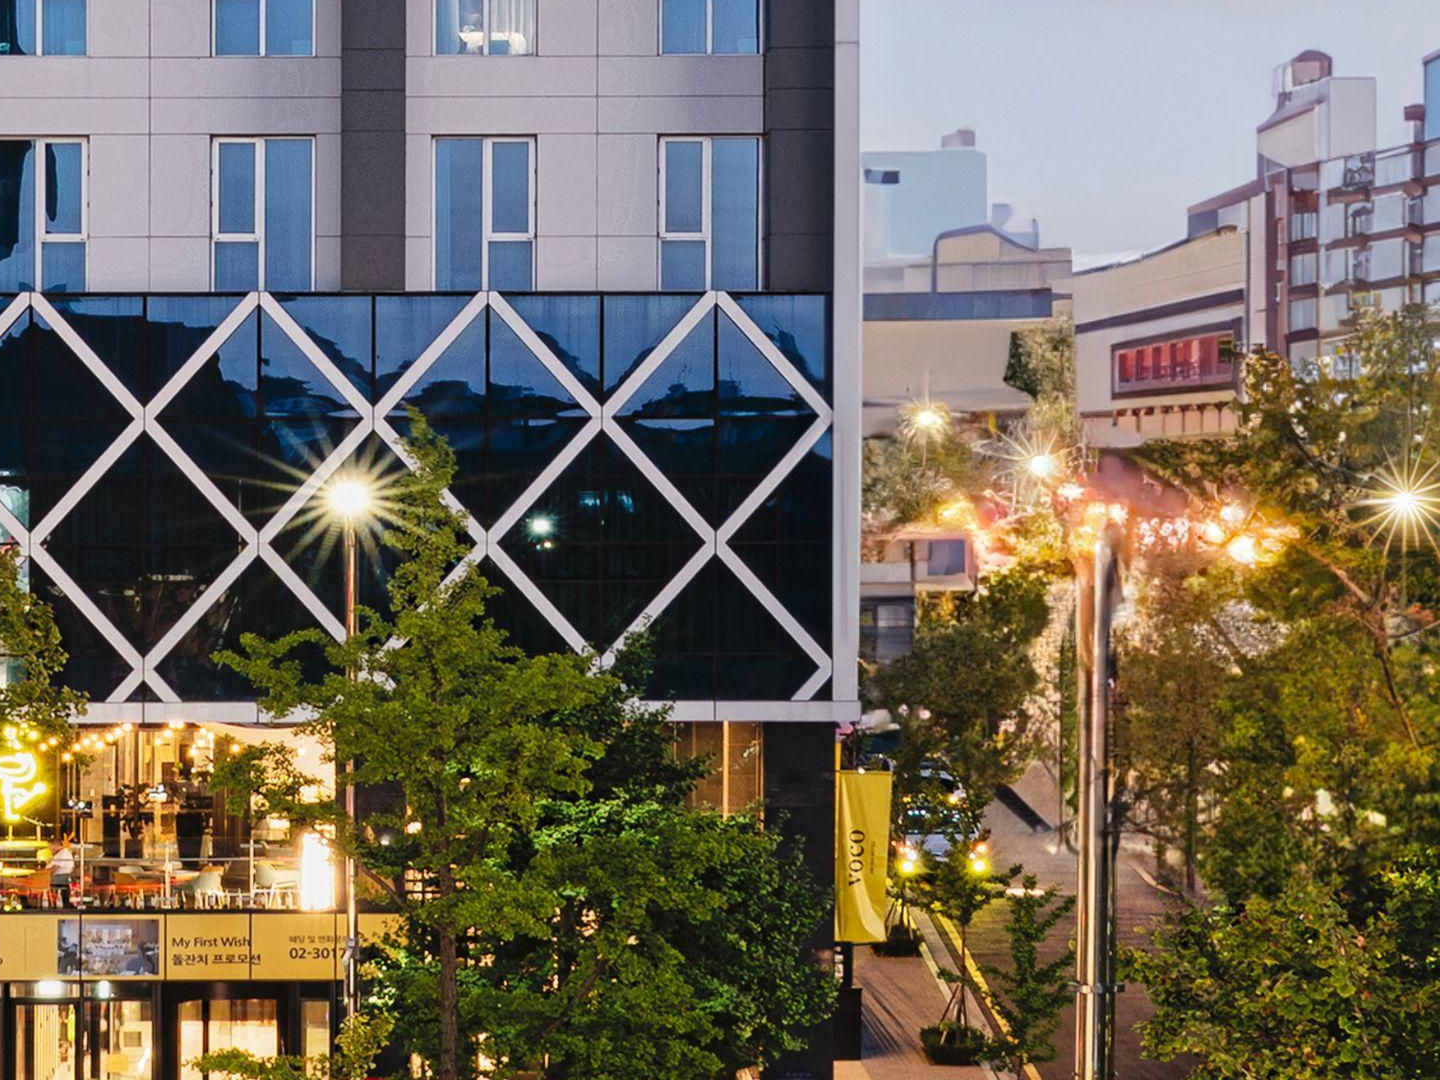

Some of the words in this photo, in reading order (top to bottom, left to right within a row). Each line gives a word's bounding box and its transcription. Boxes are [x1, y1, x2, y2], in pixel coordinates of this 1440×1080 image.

[172, 936, 191, 949] My
[193, 936, 218, 947] First
[220, 936, 251, 947] Wish
[172, 954, 208, 966] 돌잔치
[212, 954, 262, 966] 프로모션
